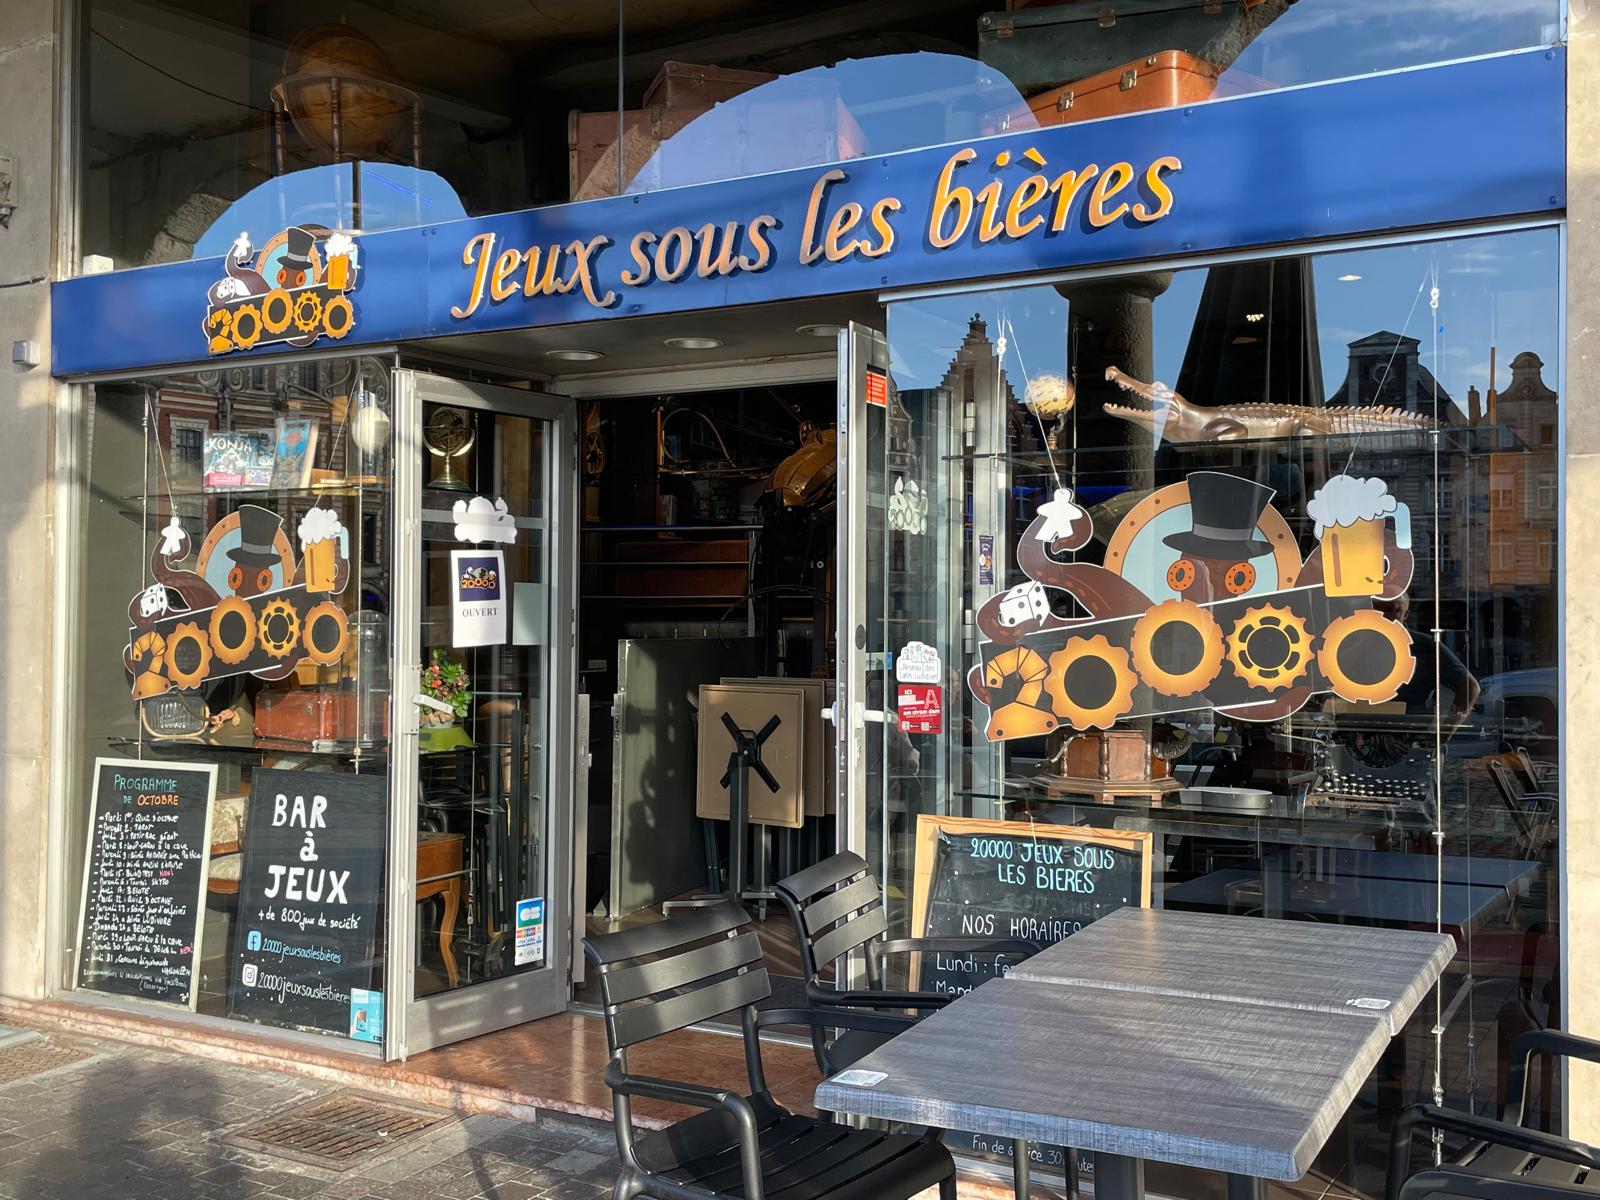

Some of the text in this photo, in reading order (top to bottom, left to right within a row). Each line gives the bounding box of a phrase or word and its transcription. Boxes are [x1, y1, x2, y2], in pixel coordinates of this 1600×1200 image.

[452, 146, 1182, 319] Jeux sous les bières
[209, 437, 252, 452] KONJA
[462, 608, 499, 618] OUVERT
[114, 773, 178, 792] PROGRAMME
[123, 794, 179, 806] DE OCTOBRE
[271, 793, 328, 829] BAR
[299, 831, 320, 863] à
[970, 837, 1116, 870] 20000 JEUX SOUS
[263, 864, 351, 905] JEUX
[998, 863, 1027, 886] LES
[265, 906, 276, 922] de
[280, 908, 301, 924] 800
[300, 915, 316, 931] jeux
[317, 913, 327, 928] de
[329, 916, 362, 931] société
[961, 914, 996, 936] NOS
[936, 952, 978, 973] Lundi
[972, 1135, 988, 1152] Fin
[992, 1141, 1005, 1155] de
[1047, 1150, 1062, 1166] 30
